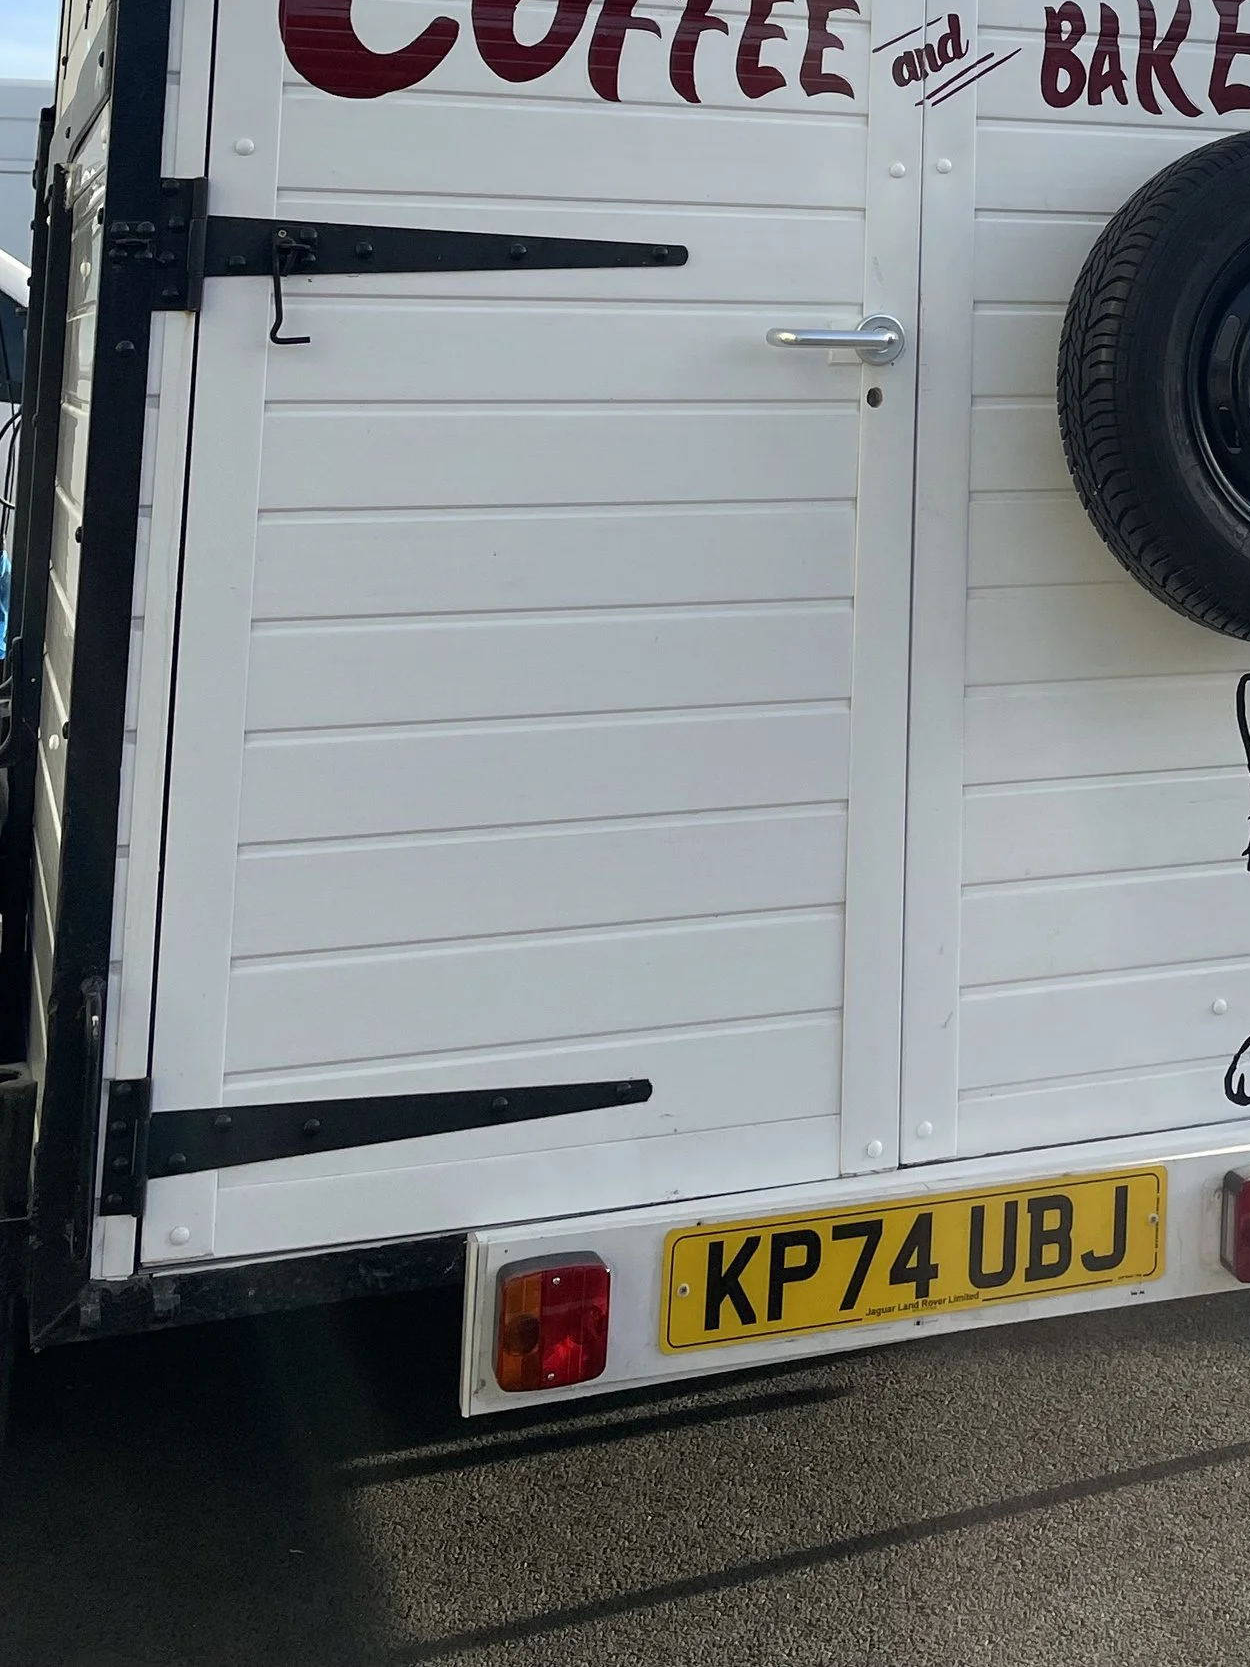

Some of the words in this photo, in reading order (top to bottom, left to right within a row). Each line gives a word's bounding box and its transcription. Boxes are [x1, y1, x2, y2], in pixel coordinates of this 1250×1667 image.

[892, 13, 970, 88] and
[704, 1212, 938, 1331] KP74
[968, 1185, 1128, 1289] UBJ
[866, 1306, 896, 1317] Jaguar
[897, 1300, 919, 1312] Land
[921, 1297, 946, 1308] Rover
[948, 1291, 980, 1304] Limited
